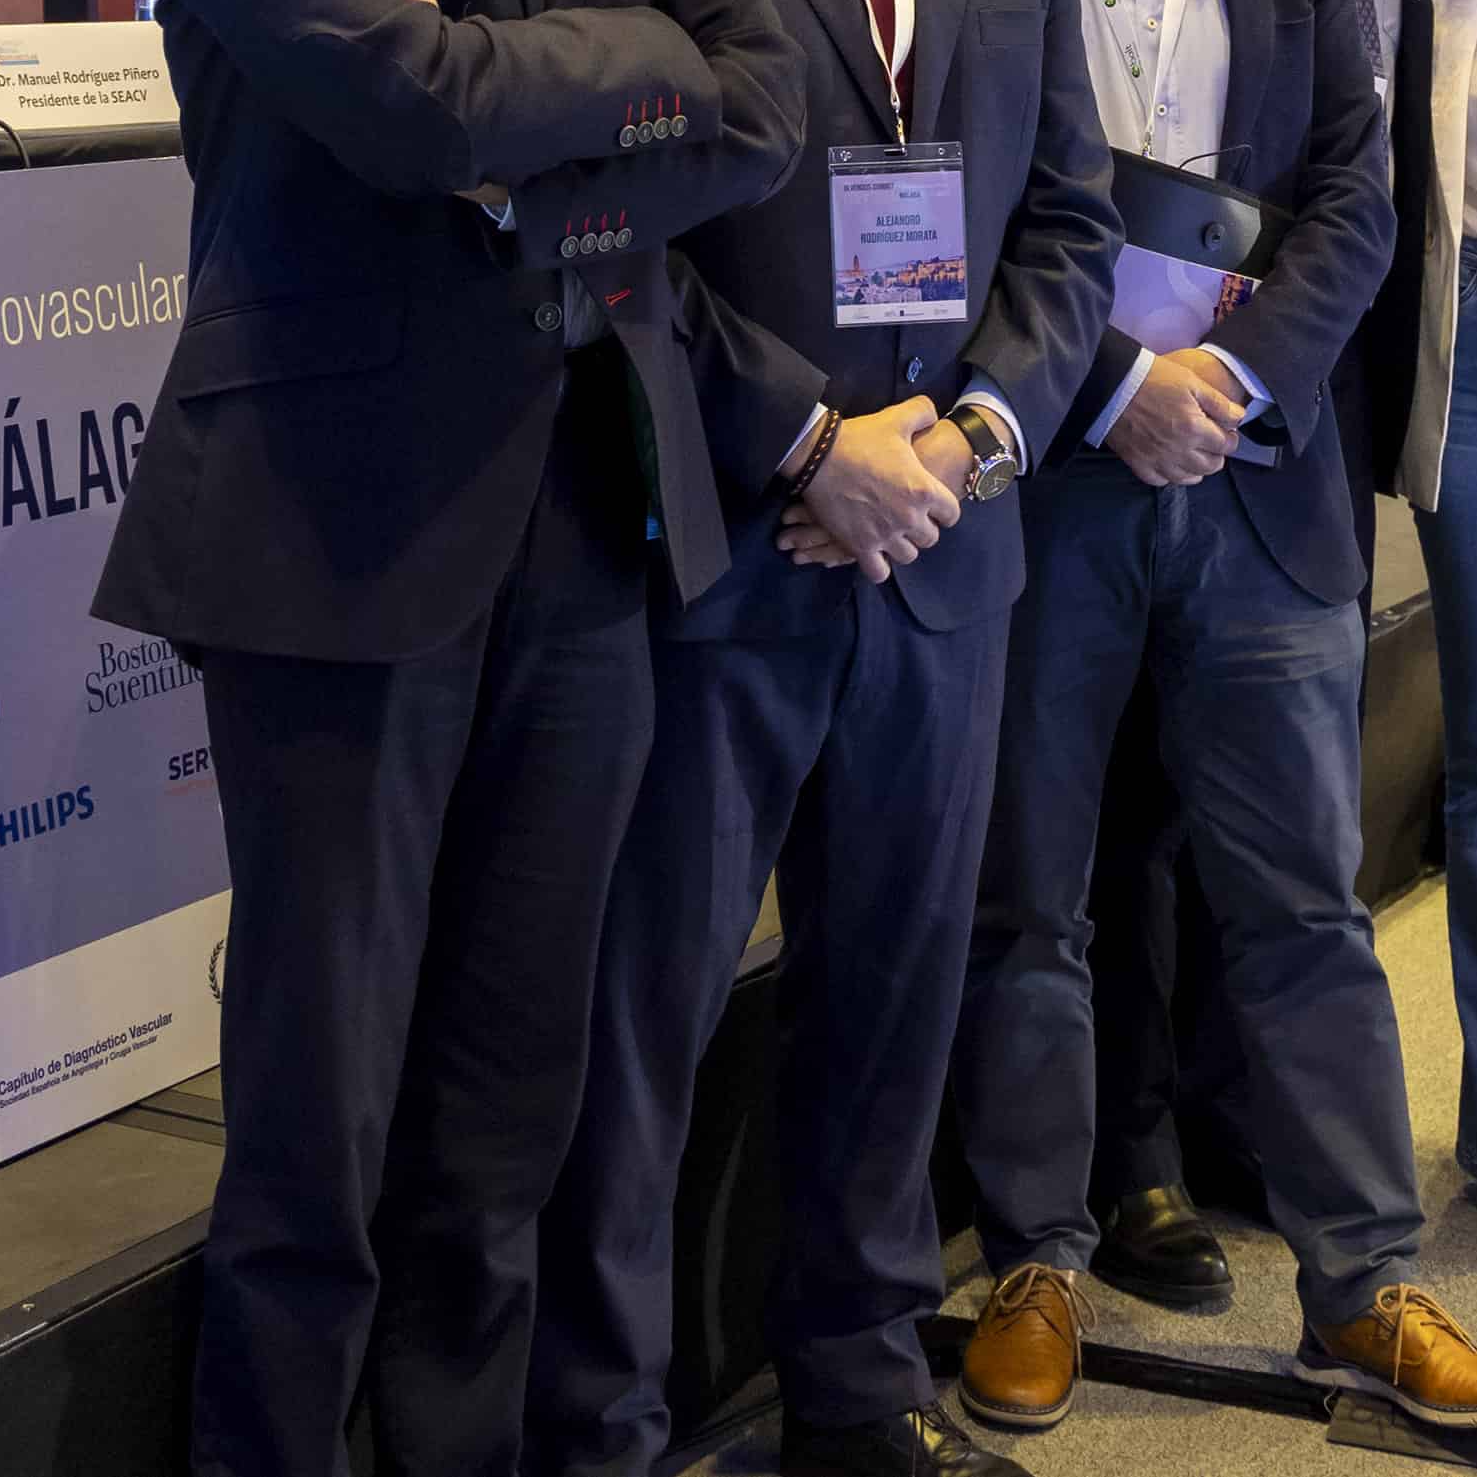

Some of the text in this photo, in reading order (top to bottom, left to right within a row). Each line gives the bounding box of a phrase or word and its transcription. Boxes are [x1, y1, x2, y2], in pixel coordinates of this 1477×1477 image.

[18, 71, 61, 86] Manuel
[63, 68, 122, 86] Rodríguez
[123, 67, 160, 80] Piñero
[19, 89, 148, 109] Presidente de la SEACV
[97, 638, 175, 679] Boston
[168, 747, 209, 781] SER
[47, 1059, 62, 1075] de
[63, 1031, 128, 1068] Diagnóstico
[128, 1011, 174, 1040] Vascular
